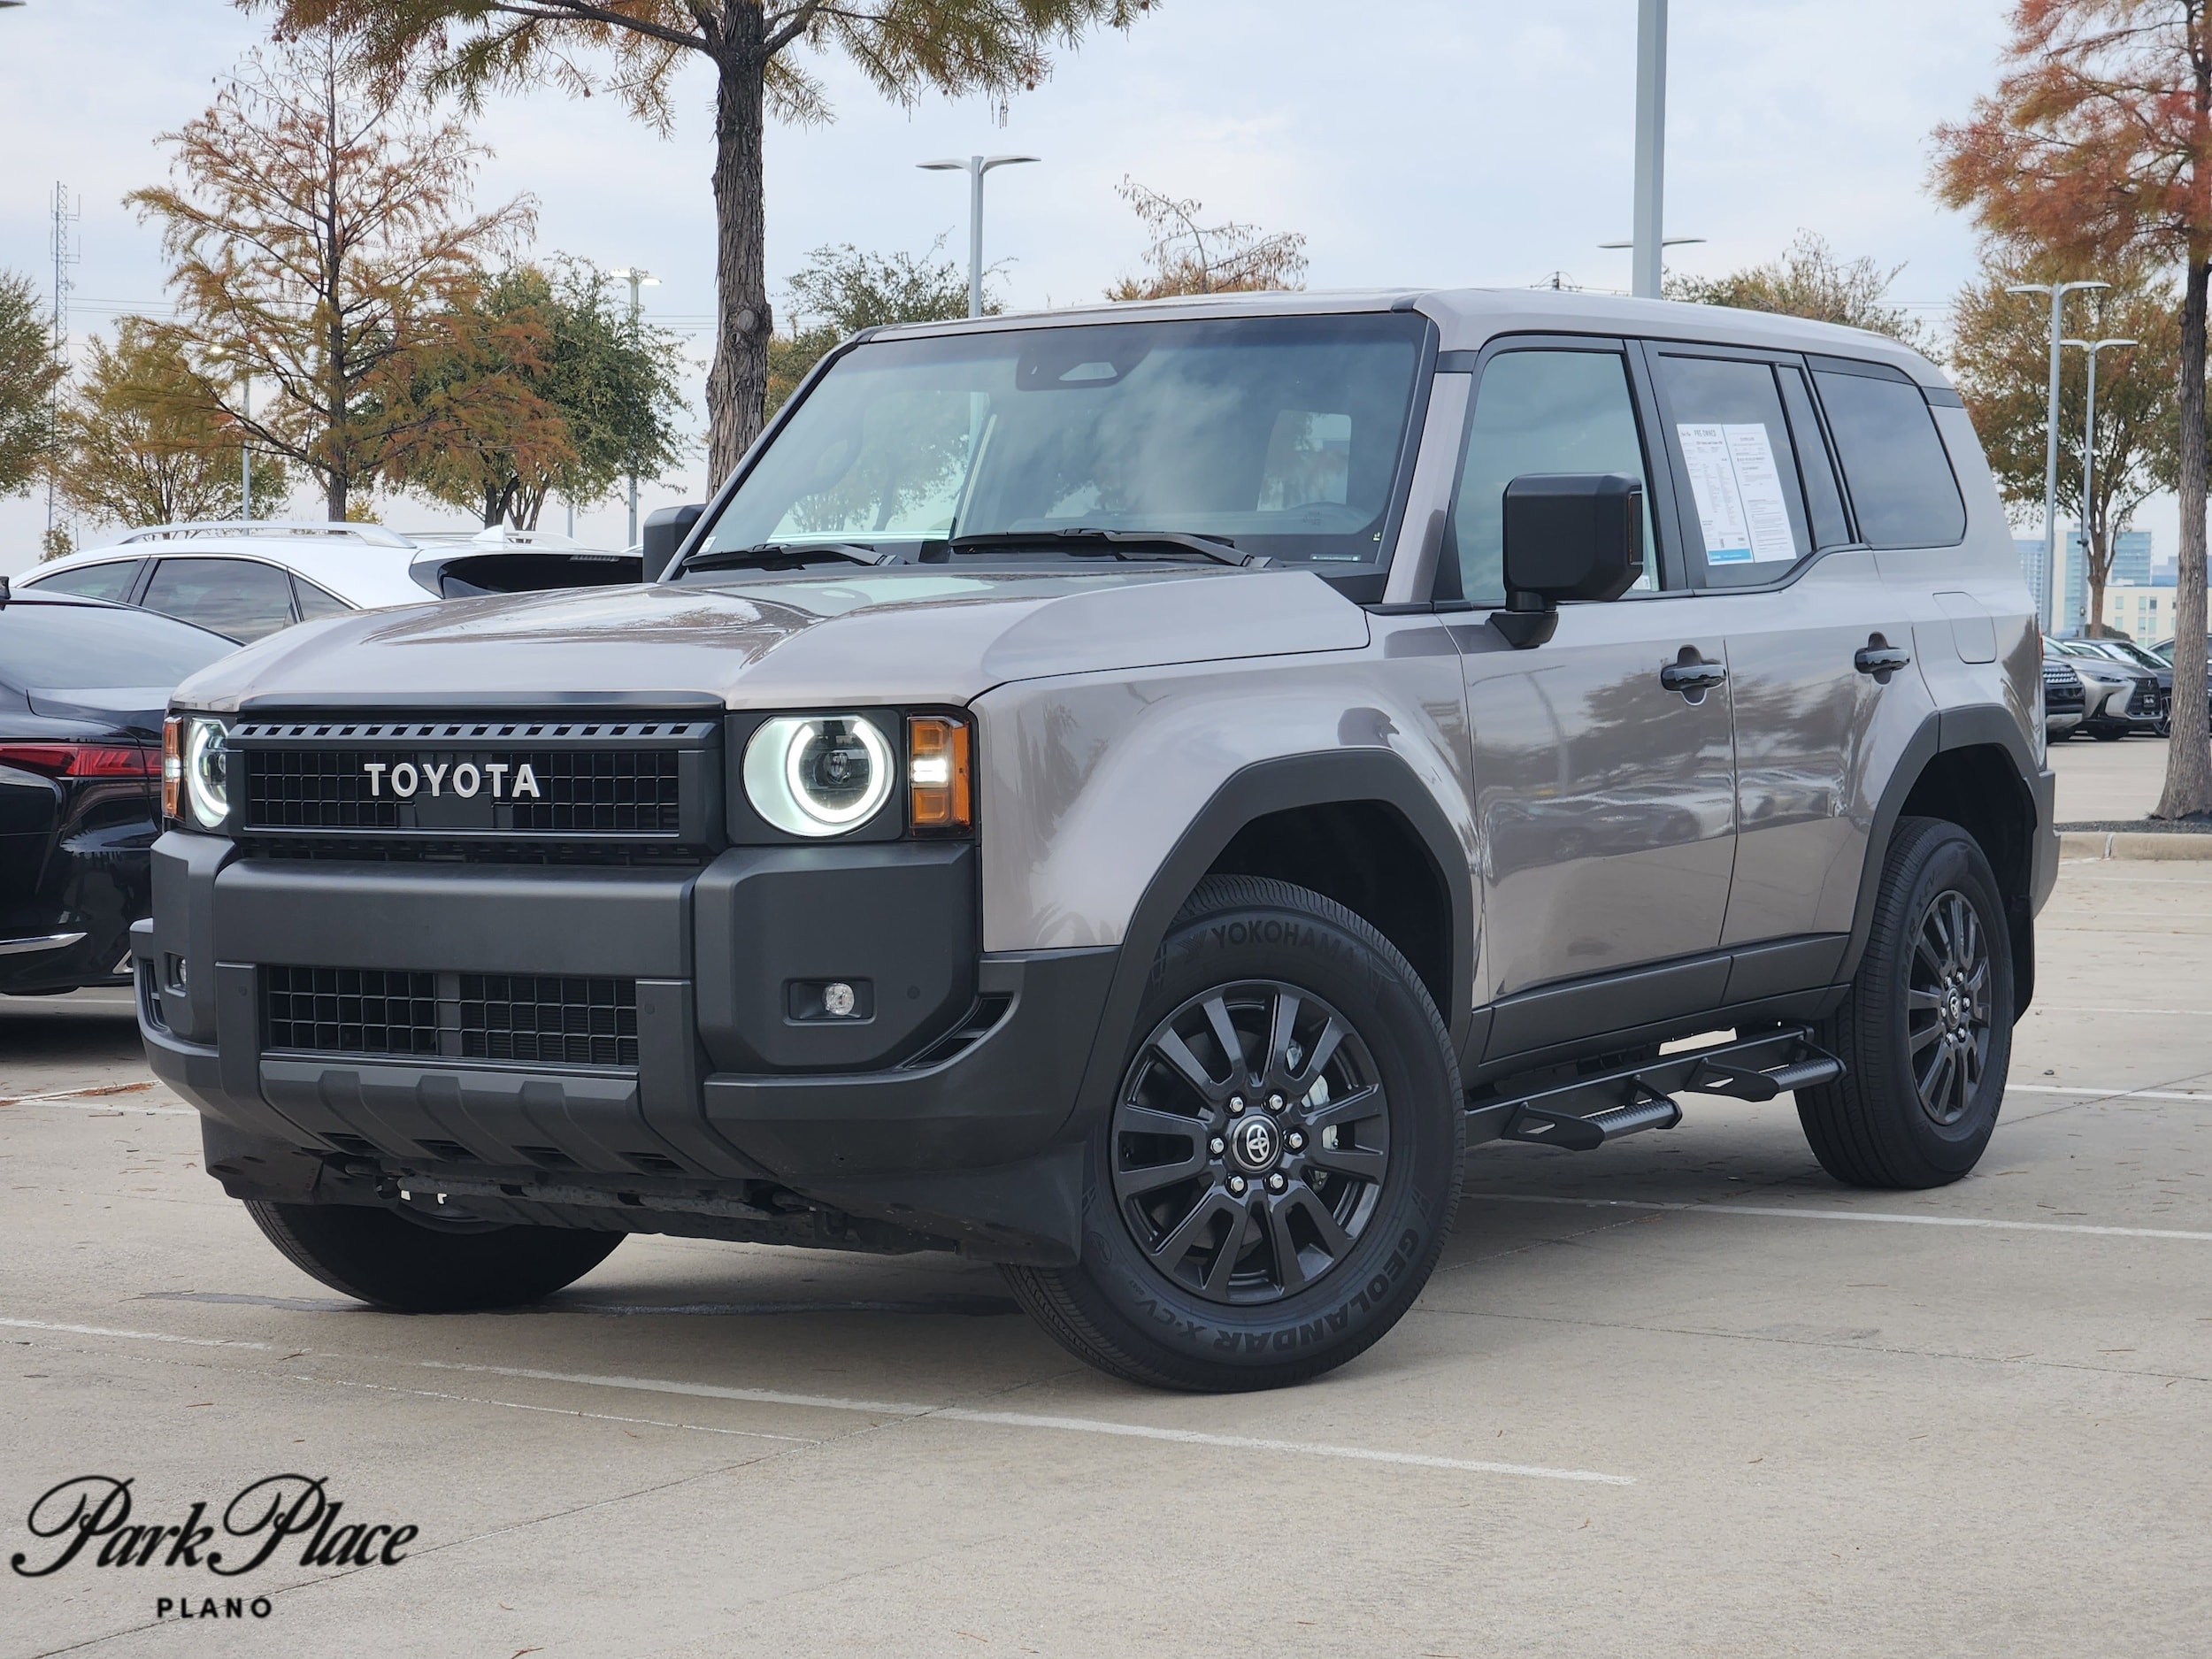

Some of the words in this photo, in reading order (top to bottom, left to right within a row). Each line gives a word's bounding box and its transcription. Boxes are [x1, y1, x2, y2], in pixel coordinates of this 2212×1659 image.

[364, 762, 541, 798] TOYOTA
[1210, 919, 1356, 964] YOKOHAMA
[1212, 1227, 1420, 1356] GEOLANDAR
